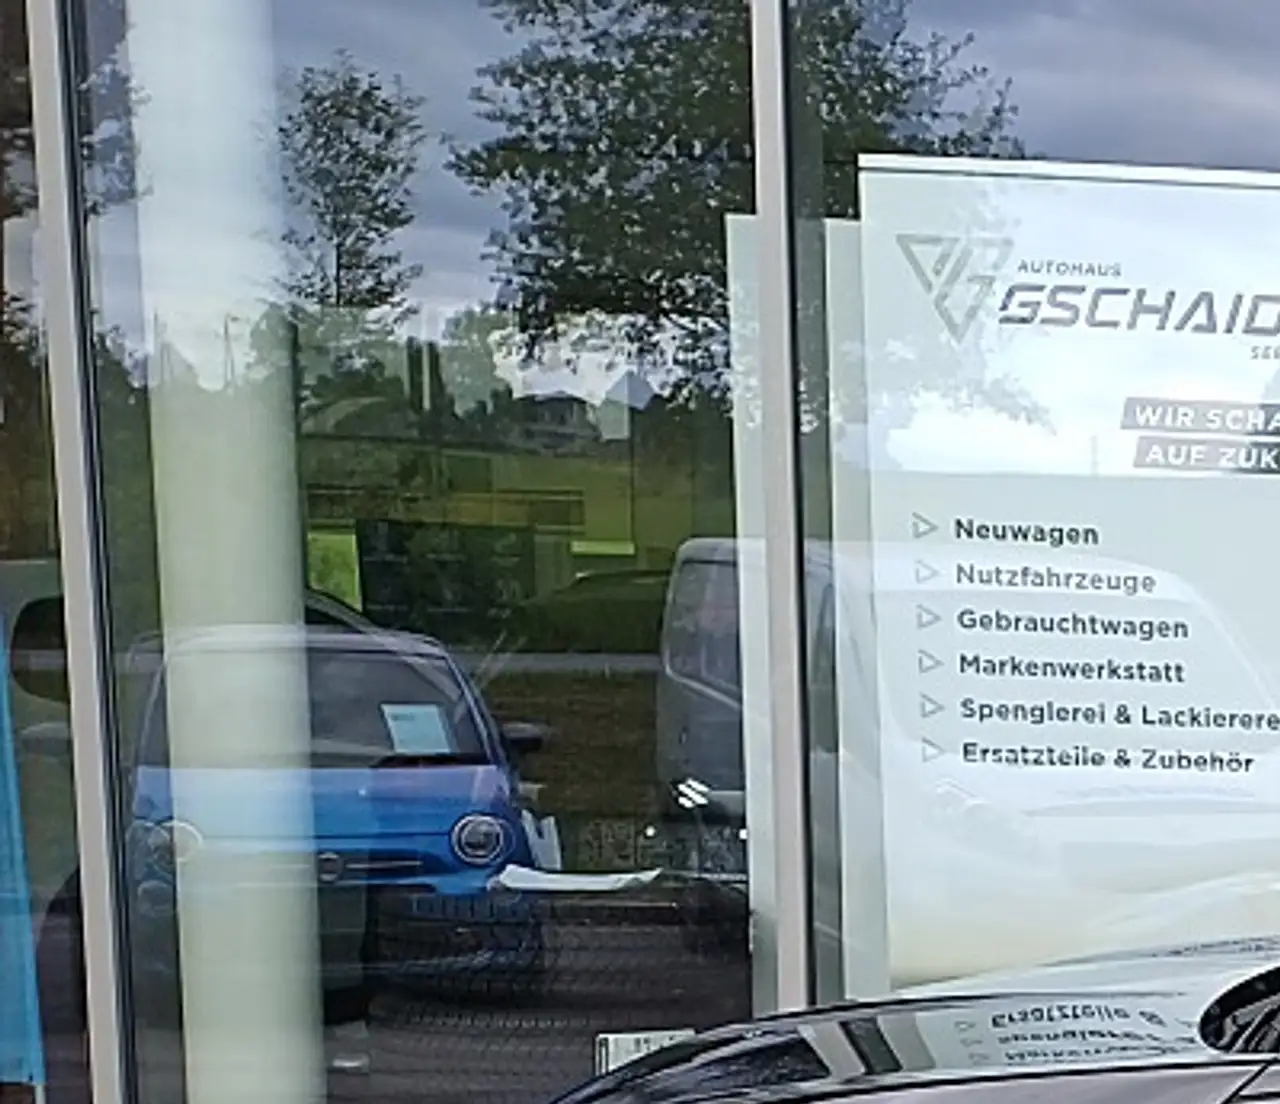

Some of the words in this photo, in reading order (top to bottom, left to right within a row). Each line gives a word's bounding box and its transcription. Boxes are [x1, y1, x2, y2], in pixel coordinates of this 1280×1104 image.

[1016, 258, 1122, 278] AUTOHAUS
[1136, 407, 1193, 428] WIR
[1145, 443, 1205, 466] AUF
[954, 517, 1099, 547] Neuwagen
[956, 562, 1156, 595] Nutzfahrzeuge
[957, 609, 1189, 641] Gebrauchtwagen
[959, 654, 1186, 684] Markenwerkstatt
[961, 699, 1106, 728] Spenglerei
[1116, 704, 1133, 724] &
[962, 744, 1106, 767] Ersatzteile
[1115, 747, 1131, 768] &
[1141, 747, 1255, 774] Zubehör
